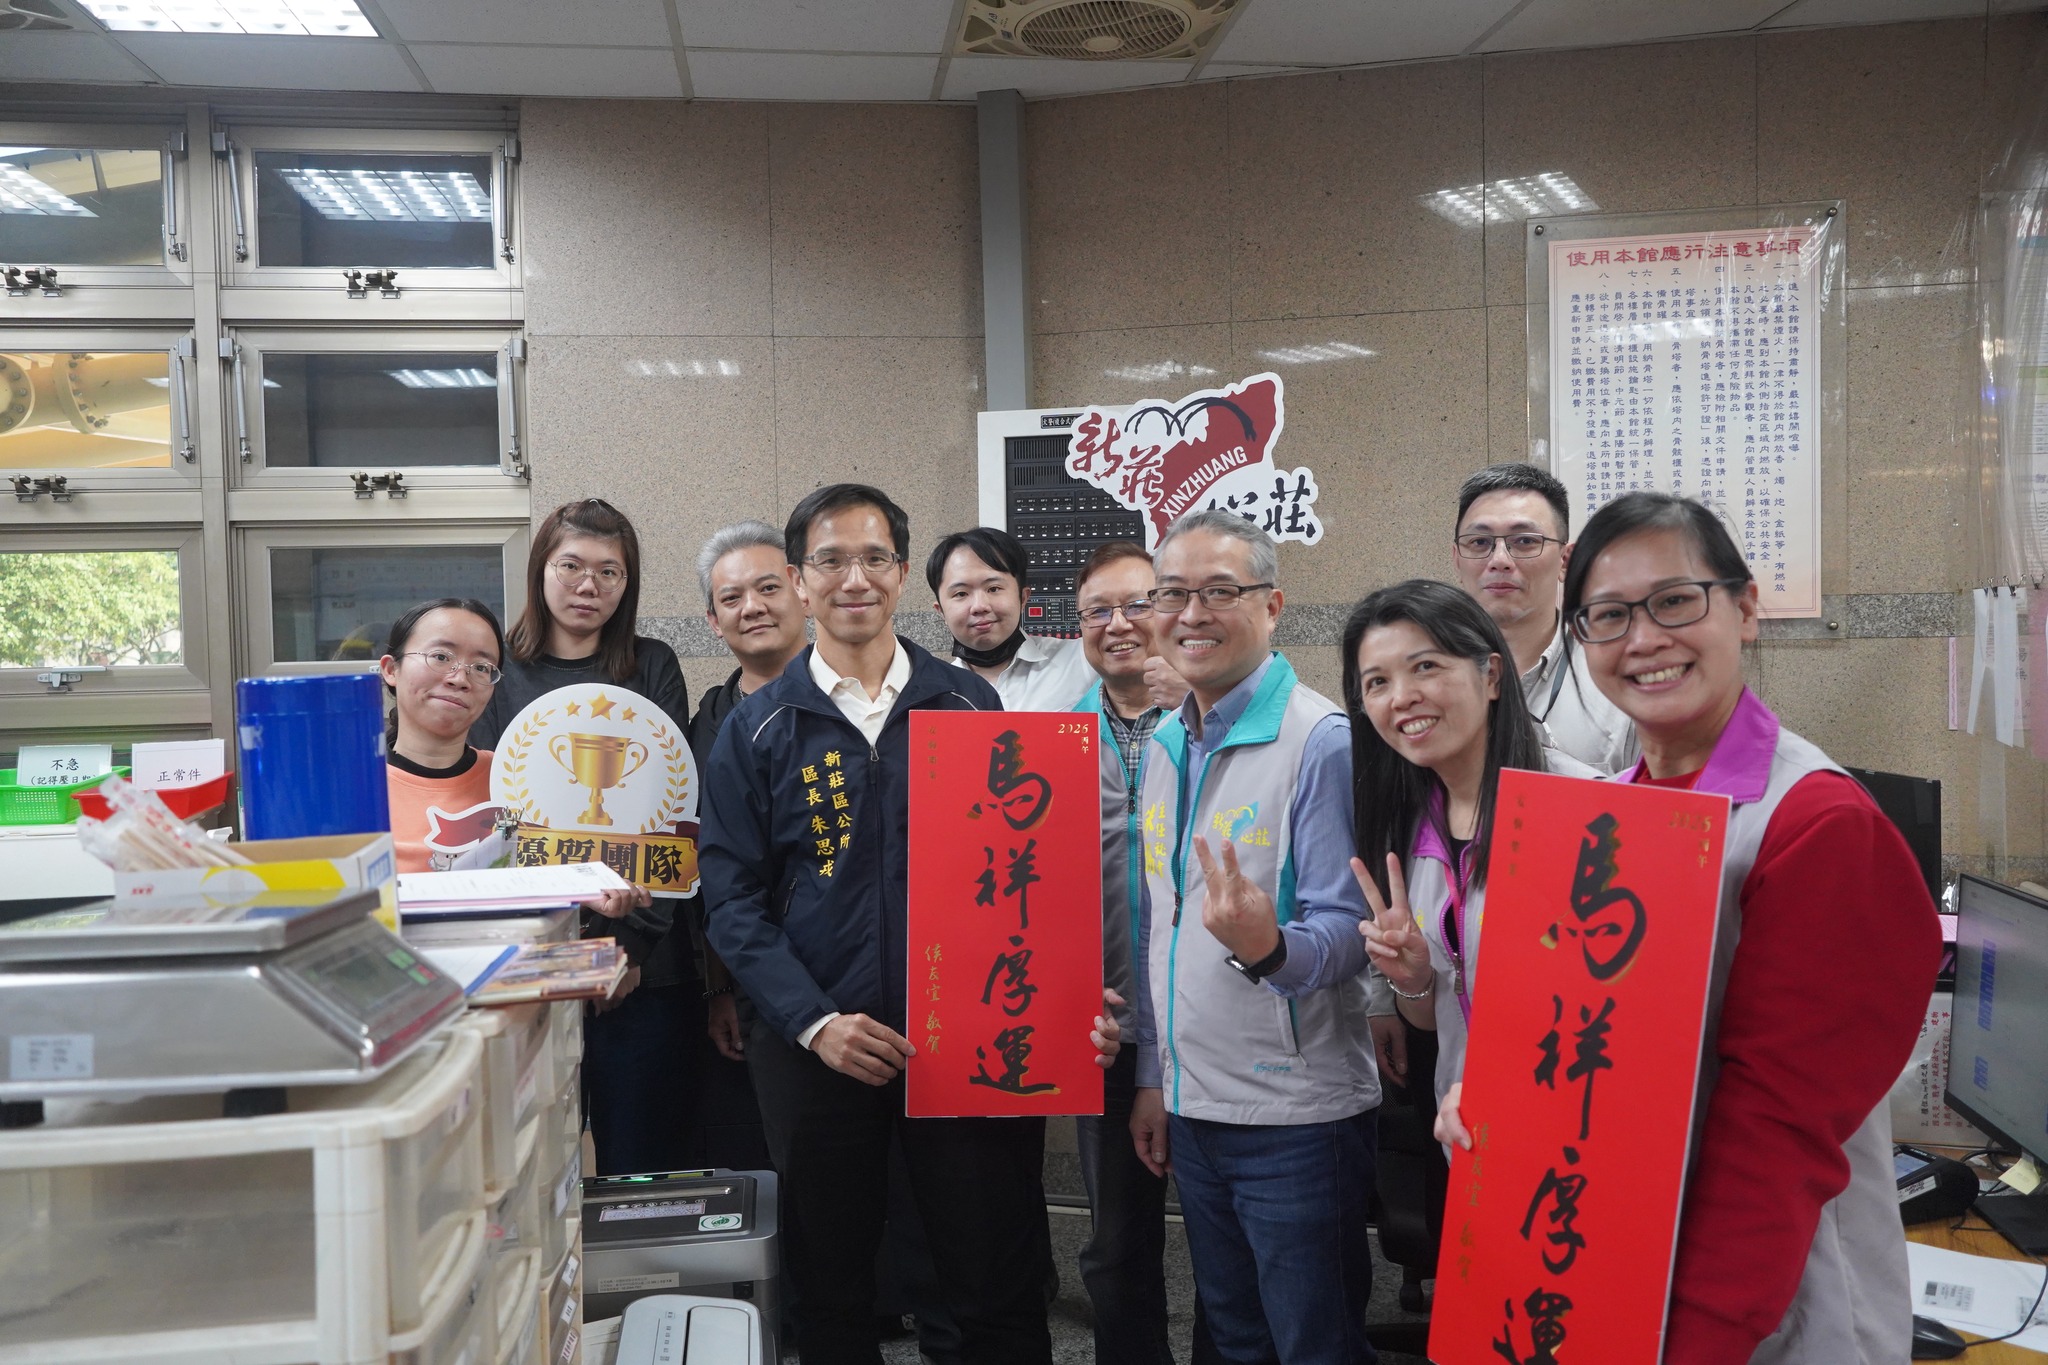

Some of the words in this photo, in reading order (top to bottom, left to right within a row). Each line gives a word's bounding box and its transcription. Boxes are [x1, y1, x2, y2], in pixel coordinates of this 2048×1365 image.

[1566, 238, 1801, 268] 使用本館應行注意事項
[1159, 446, 1248, 519] XINZHUANG
[1058, 723, 1089, 734] 2026
[50, 757, 80, 771] 不急
[156, 768, 202, 783] 正常件
[801, 764, 824, 807] 區長
[823, 751, 853, 850] 新莊區公所
[966, 729, 1062, 1094] 馬祥厚運
[1492, 812, 1647, 1365] 馬祥厚運
